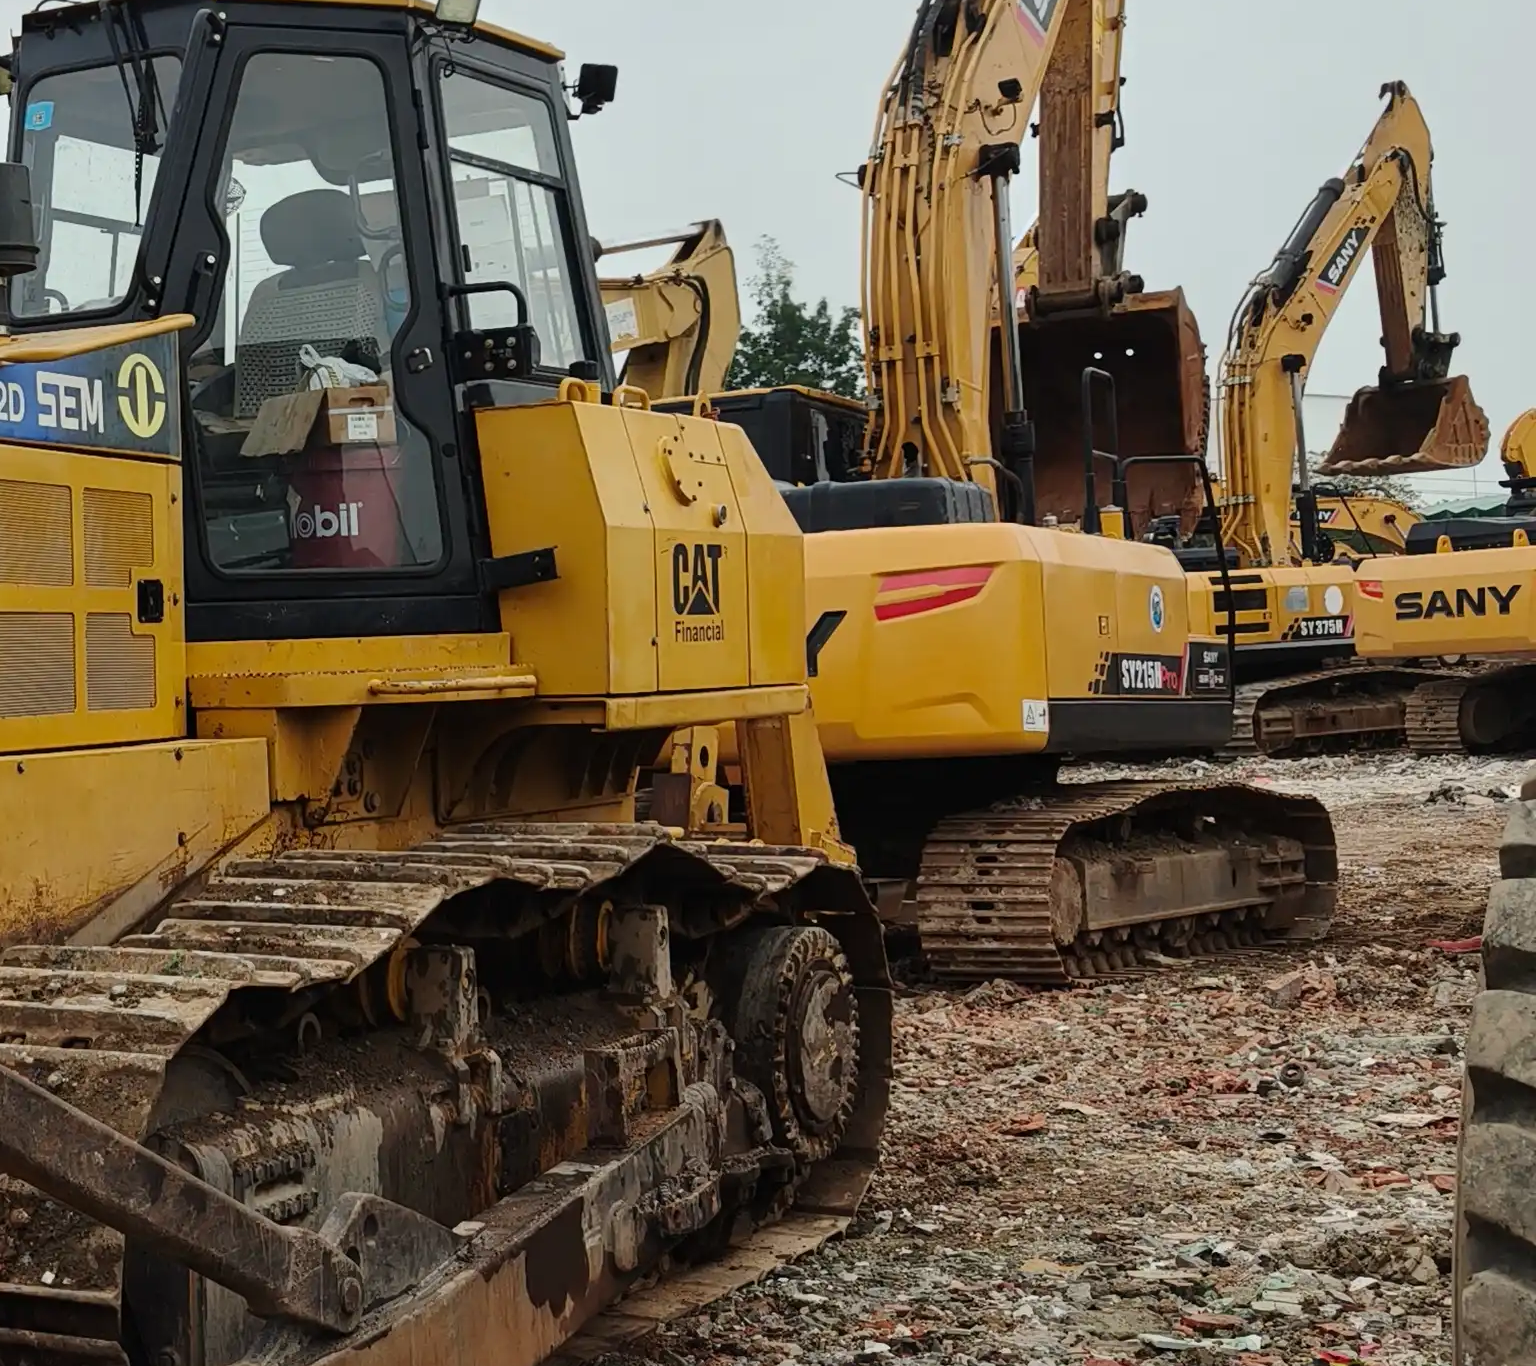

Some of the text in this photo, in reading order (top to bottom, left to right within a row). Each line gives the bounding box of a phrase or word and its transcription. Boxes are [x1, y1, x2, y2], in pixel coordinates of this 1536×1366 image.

[1328, 230, 1358, 283] SANY
[36, 371, 104, 433] SEM
[673, 543, 722, 615] CAT
[1395, 585, 1521, 620] SANY
[675, 620, 724, 642] Financial
